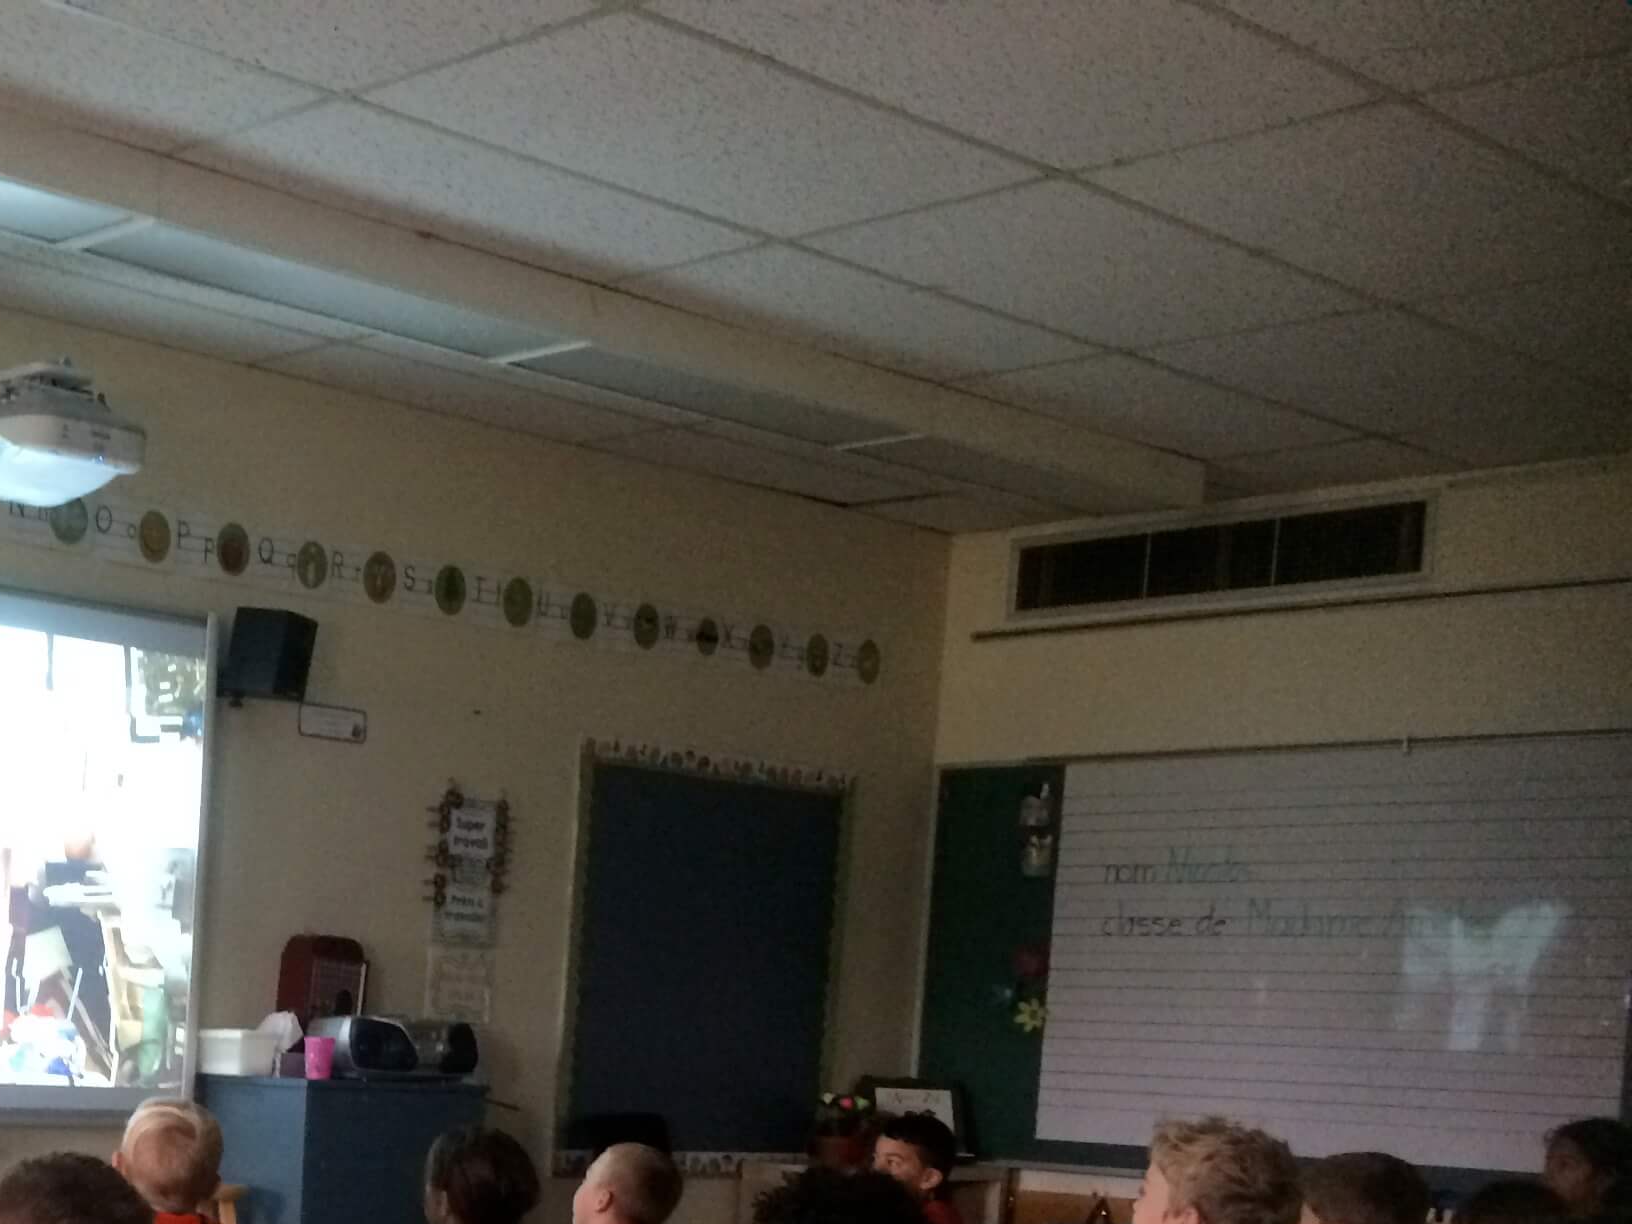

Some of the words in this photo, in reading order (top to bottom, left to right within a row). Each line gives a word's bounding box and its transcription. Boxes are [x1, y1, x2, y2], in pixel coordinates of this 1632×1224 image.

[95, 504, 113, 534] O
[177, 520, 191, 546] P
[330, 551, 344, 578] R
[402, 564, 417, 591] S
